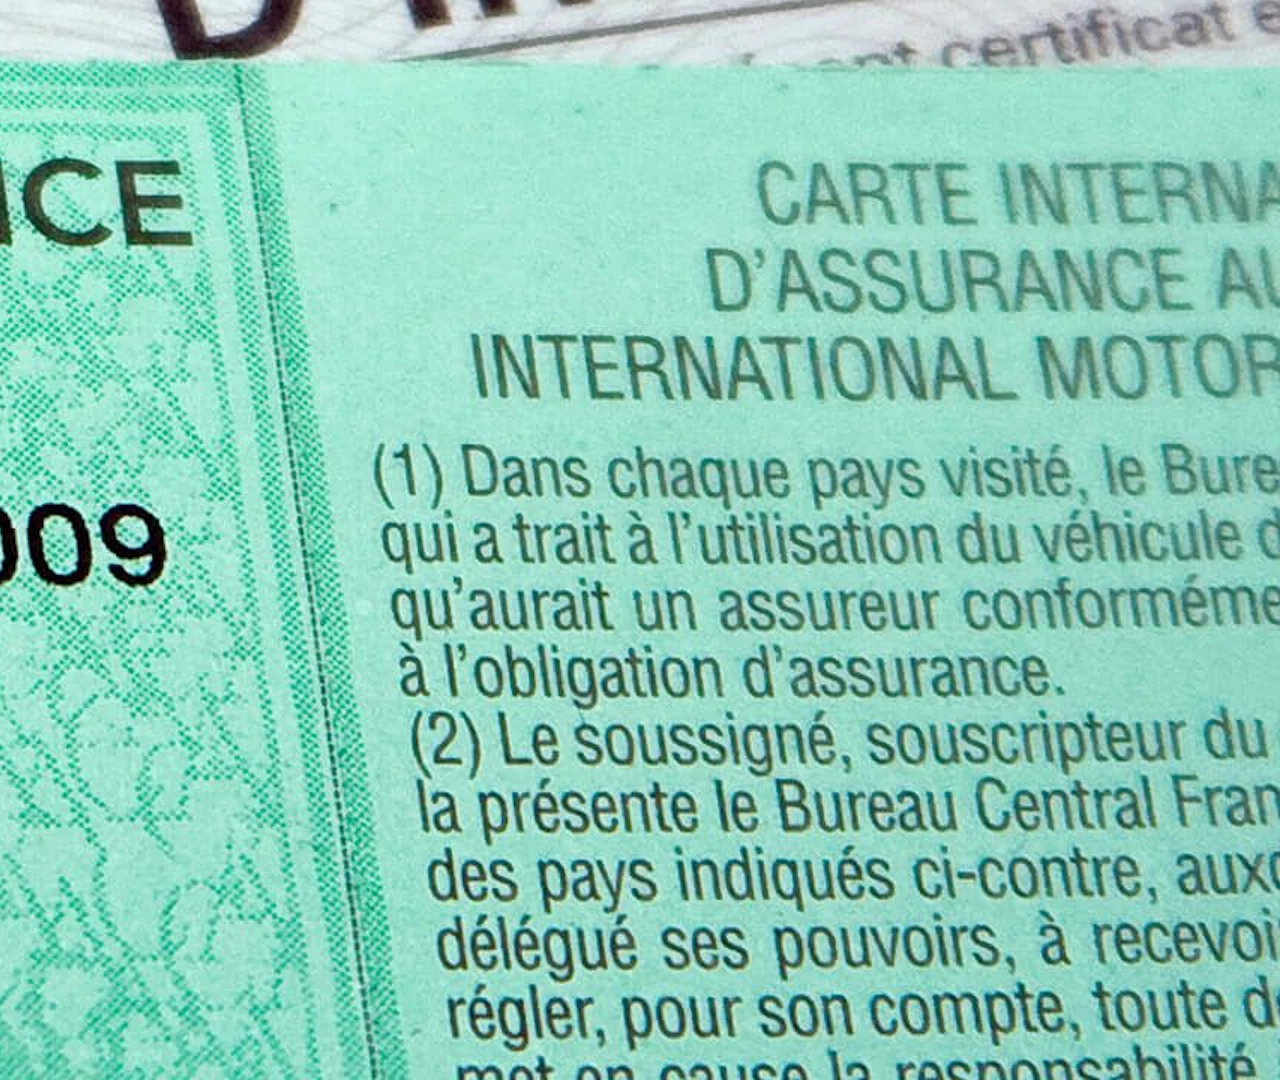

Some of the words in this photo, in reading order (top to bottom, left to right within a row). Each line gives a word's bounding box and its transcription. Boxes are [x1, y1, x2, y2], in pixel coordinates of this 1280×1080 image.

[942, 0, 1238, 70] certificat
[755, 159, 979, 227] CARTE
[704, 245, 1195, 316] D'ASSURANCE
[469, 332, 1019, 403] INTERNATIONAL
[1034, 332, 1280, 402] MOTOR
[372, 441, 444, 511] (1)
[460, 442, 593, 499] Dans
[606, 444, 792, 512] chaque
[806, 456, 927, 512] pays
[937, 442, 1090, 503] visité,
[1100, 442, 1147, 498] le
[380, 510, 460, 576] qui
[472, 521, 502, 565] a
[512, 513, 618, 566] trait
[626, 513, 660, 565] à
[668, 510, 944, 567] l'utilisation
[955, 510, 1022, 566] du
[1031, 507, 1245, 565] véhicule
[389, 579, 616, 643] qu'aurait
[631, 588, 698, 633] un
[717, 588, 941, 633] assureur
[397, 644, 432, 699] à
[442, 642, 725, 711] l'obligation
[741, 643, 1066, 700] d'assurance.
[410, 709, 482, 781] (2)
[496, 710, 560, 767] Le
[572, 709, 852, 778] soussigné,
[866, 708, 1188, 776] souscripteur
[1202, 704, 1270, 761] du
[415, 777, 464, 835] la
[476, 776, 700, 847] présente
[712, 778, 760, 834] le
[774, 777, 959, 834] Bureau
[973, 774, 1158, 833] Central
[426, 846, 519, 903] des
[536, 857, 659, 916] pays
[673, 844, 896, 912] indiqués
[911, 844, 1158, 905] ci-contre,
[435, 912, 639, 984] délégué
[660, 925, 750, 971] ses
[771, 911, 1017, 983] pouvoirs,
[1038, 908, 1073, 967] à
[446, 982, 607, 1053] régler,
[620, 994, 744, 1052] pour
[757, 993, 855, 1039] son
[868, 980, 1082, 1048] compte,
[1090, 978, 1229, 1034] toute
[1241, 973, 1280, 1030] d
